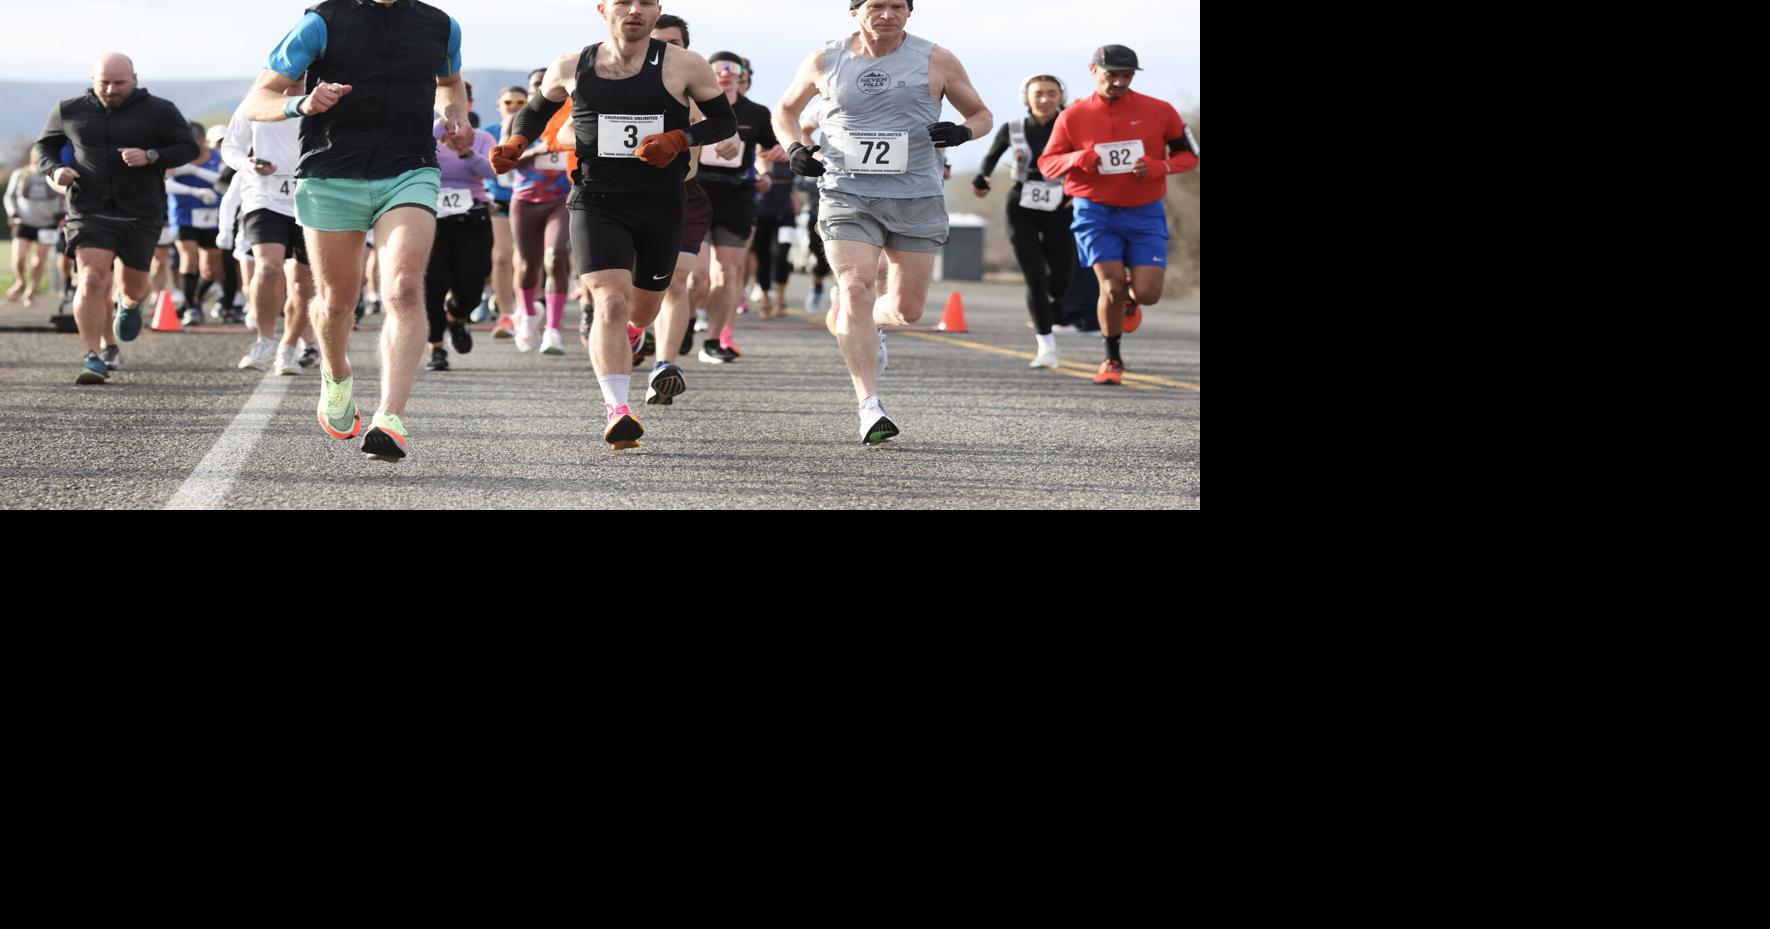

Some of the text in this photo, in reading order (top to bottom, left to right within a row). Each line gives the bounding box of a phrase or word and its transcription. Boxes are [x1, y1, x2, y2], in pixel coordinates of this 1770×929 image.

[624, 125, 638, 149] 3
[860, 141, 890, 165] 72
[1109, 149, 1132, 166] 82
[443, 193, 462, 208] 42
[1032, 188, 1050, 203] 84
